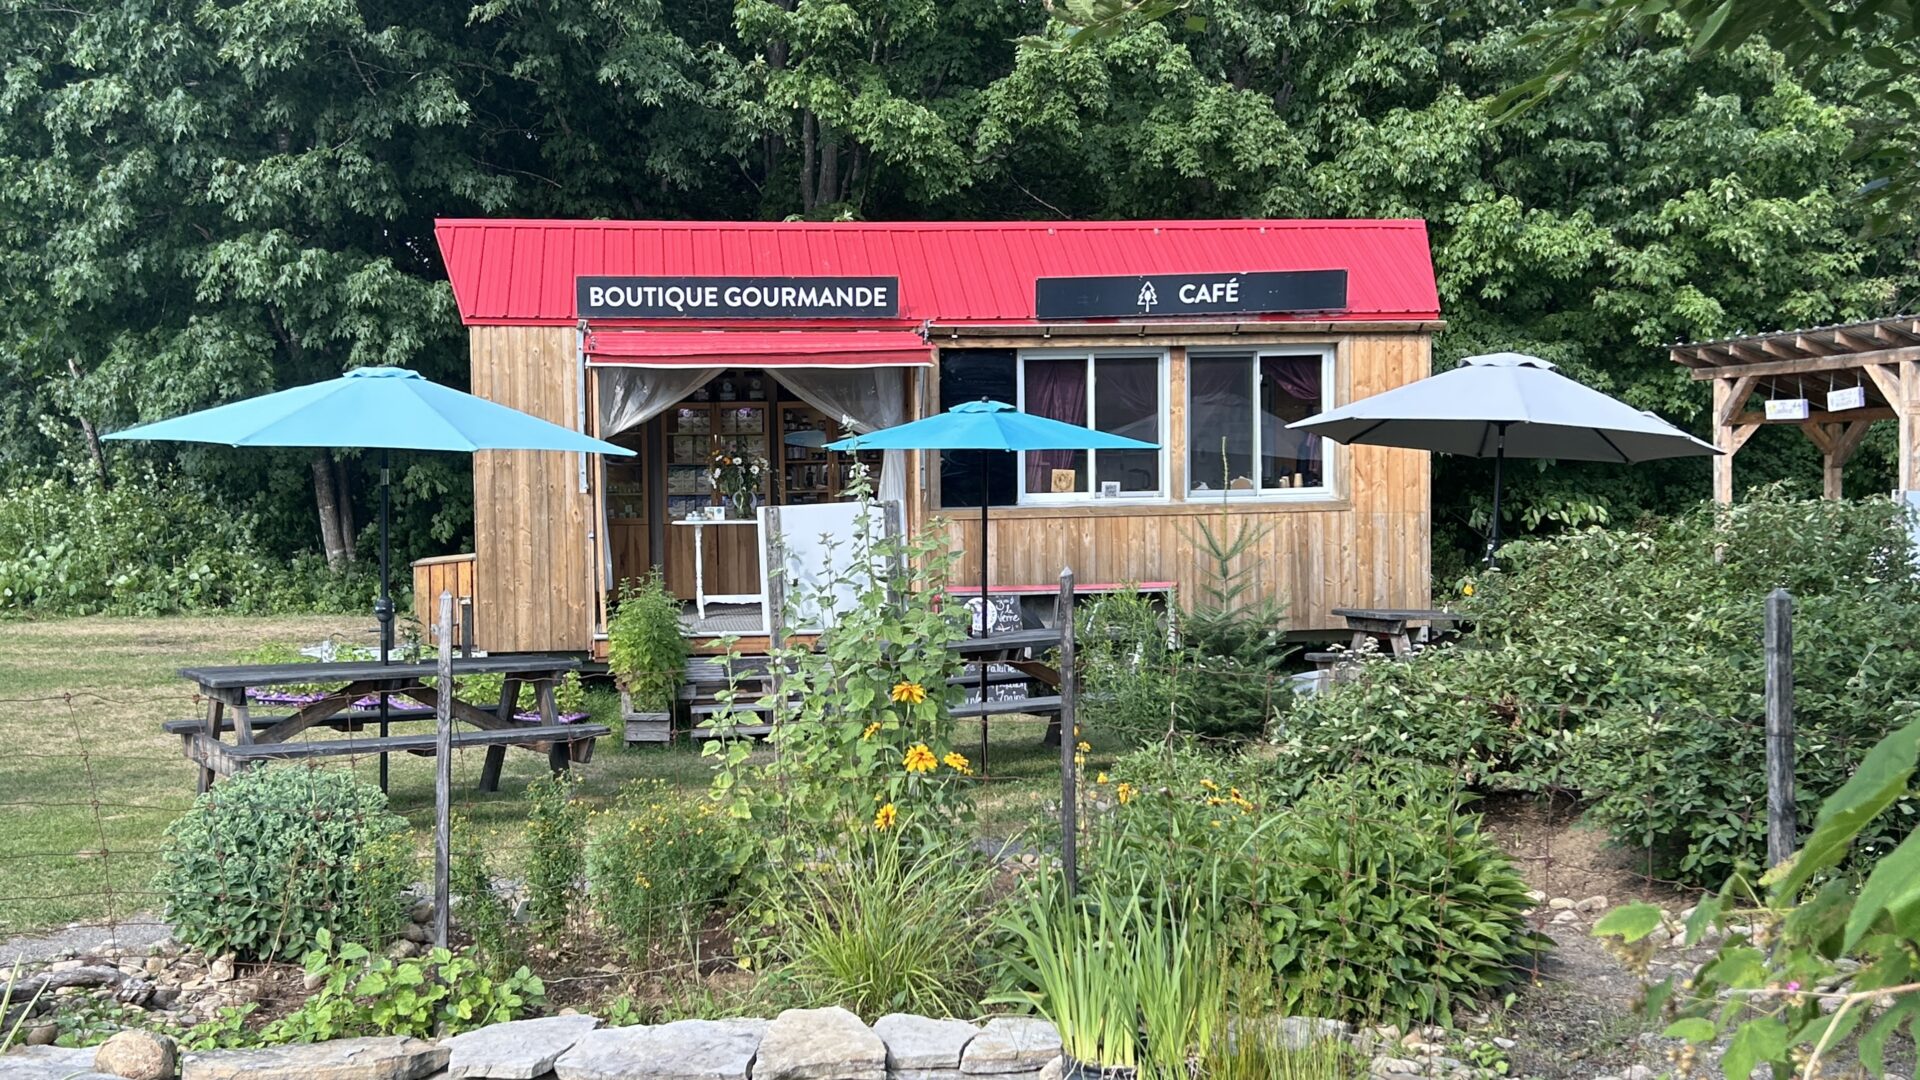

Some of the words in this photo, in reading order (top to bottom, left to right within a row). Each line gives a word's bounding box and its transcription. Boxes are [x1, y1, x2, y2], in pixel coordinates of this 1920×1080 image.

[589, 286, 719, 311] BOUTIQUE
[723, 286, 887, 308] GOURMANDE
[1178, 278, 1240, 304] CAFÉ
